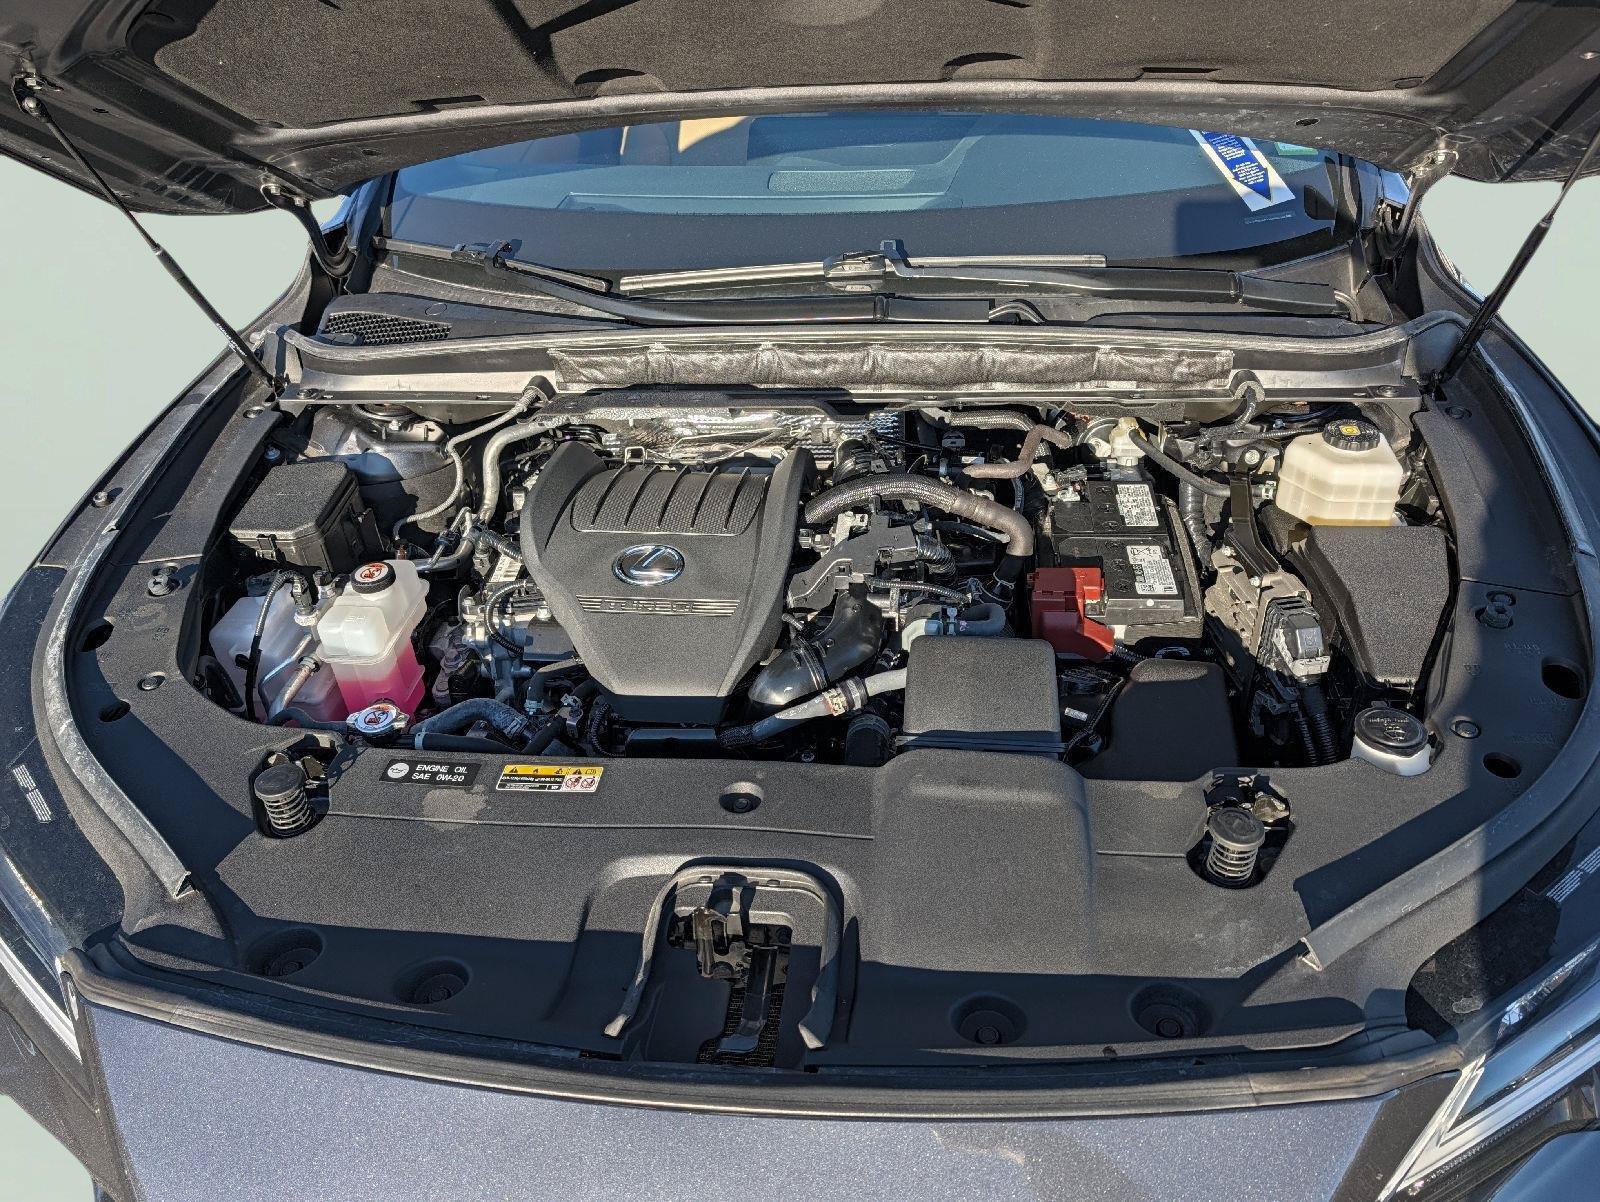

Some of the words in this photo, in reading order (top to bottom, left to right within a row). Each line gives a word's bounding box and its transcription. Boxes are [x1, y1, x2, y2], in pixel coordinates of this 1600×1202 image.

[415, 764, 450, 773] ENGINE
[454, 766, 468, 774] OIL
[436, 774, 465, 782] 0W-20
